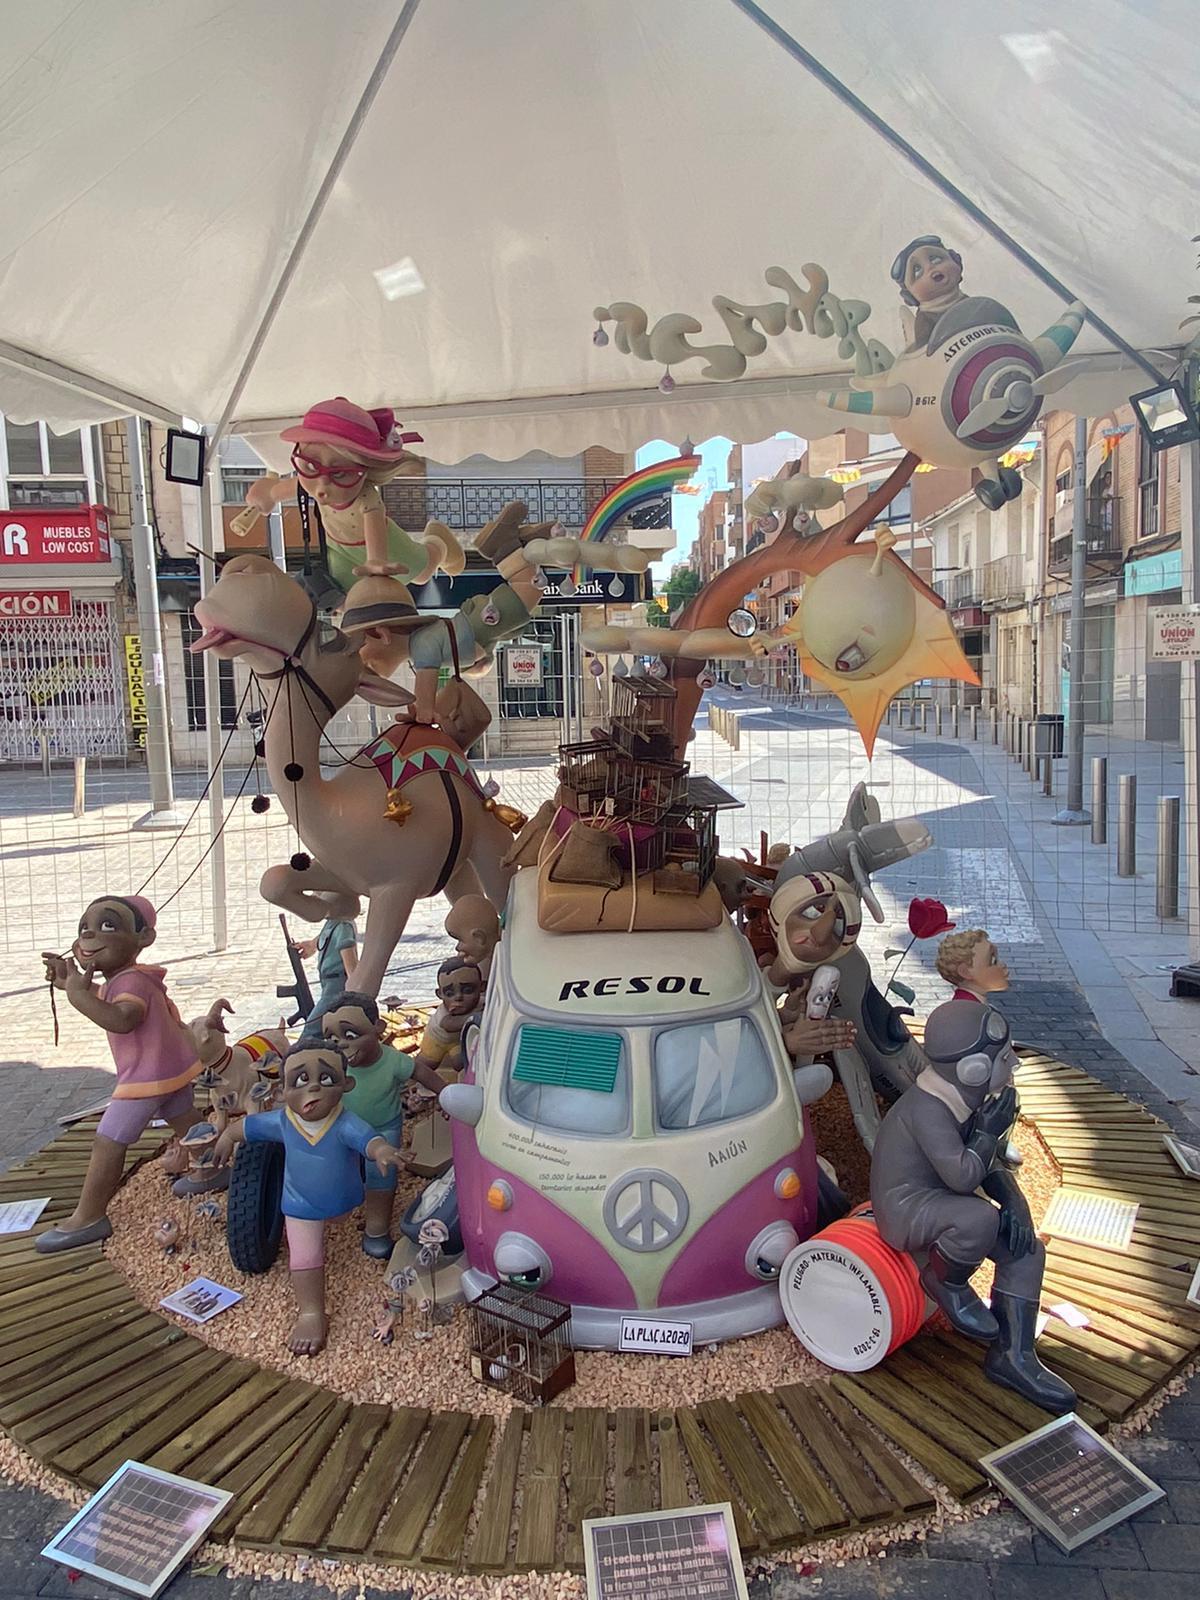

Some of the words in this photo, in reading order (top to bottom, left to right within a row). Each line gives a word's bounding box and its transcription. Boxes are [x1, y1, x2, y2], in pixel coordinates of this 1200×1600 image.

[43, 526, 91, 539] MUEBLES
[42, 542, 65, 554] LOW
[67, 541, 94, 553] COST
[558, 976, 710, 1001] RESOL
[810, 1252, 847, 1267] MATERIAL
[849, 1263, 882, 1315] INFLAMABLE
